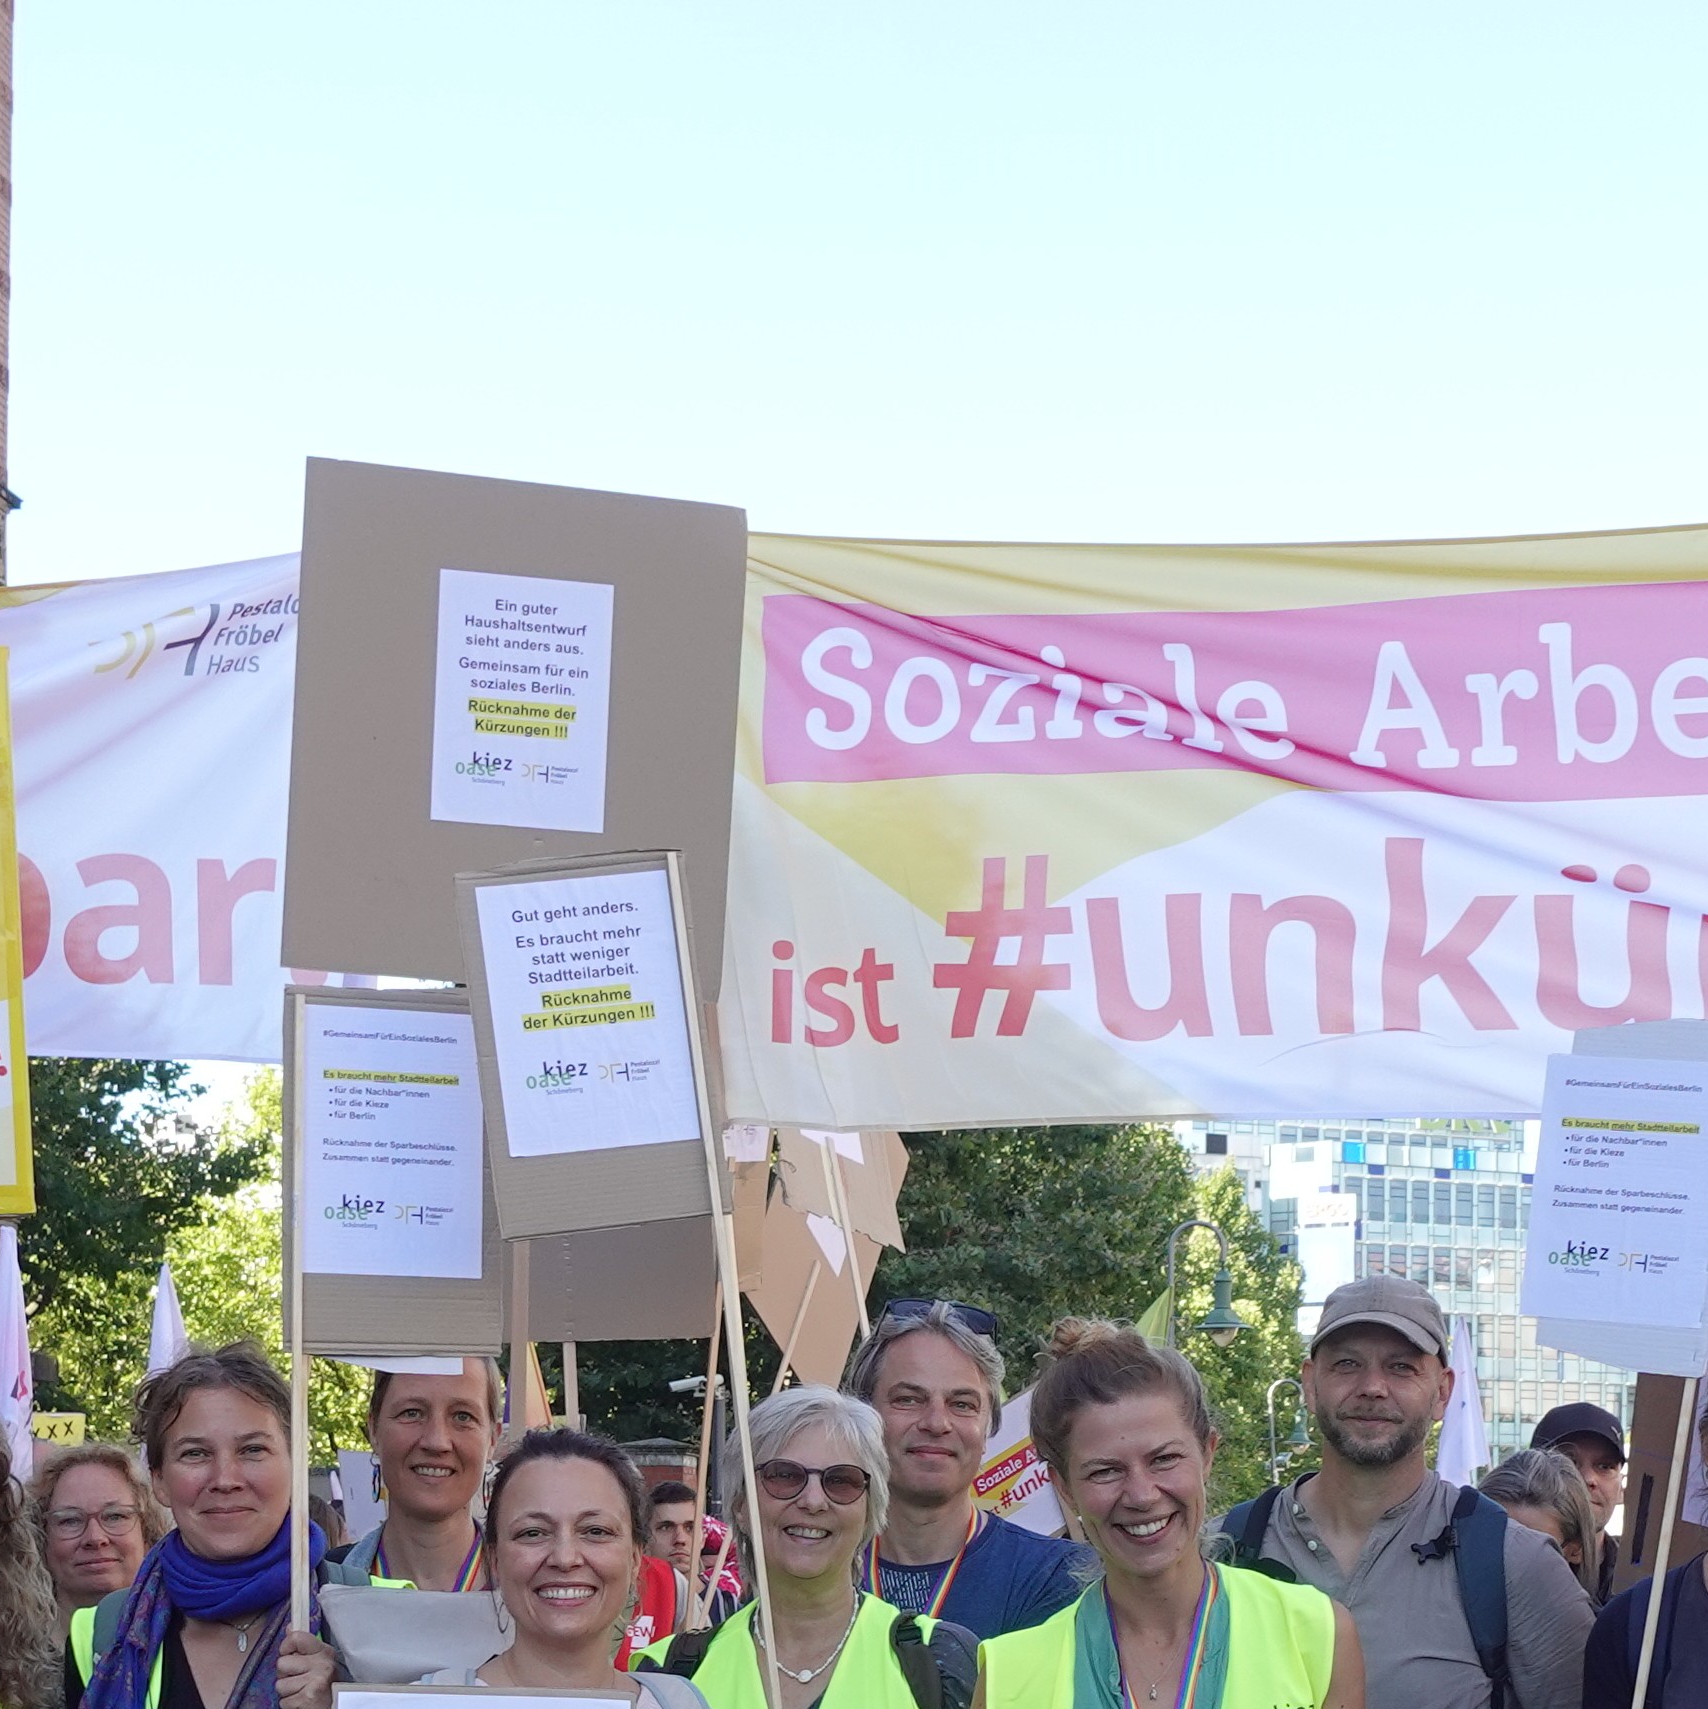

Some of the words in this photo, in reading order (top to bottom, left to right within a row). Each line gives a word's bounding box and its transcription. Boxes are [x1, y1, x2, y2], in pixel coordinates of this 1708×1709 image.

[228, 594, 300, 621] Pestal
[495, 598, 517, 612] Ein
[521, 604, 558, 616] guter
[213, 623, 284, 646] Fröbel
[465, 614, 587, 636] Haushaltsentwurf
[465, 634, 499, 647] sieht
[503, 638, 551, 652] anders
[555, 644, 583, 655] aus.
[206, 655, 260, 676] Haus
[458, 656, 540, 674] Gemeinsam
[545, 663, 564, 676] für
[568, 667, 588, 679] ein
[470, 678, 526, 692] soziales
[531, 681, 575, 696] Berlin.
[800, 626, 1295, 761] Soziale
[468, 699, 550, 718] Rücknahme
[554, 707, 576, 720] der
[475, 718, 550, 737] Kürzungen
[555, 725, 568, 738] !!!
[455, 761, 497, 777] oase
[472, 751, 513, 772] kiez
[511, 910, 539, 923] Gut
[543, 906, 577, 923] geht
[582, 901, 638, 916] anders.
[515, 935, 535, 948] Es
[539, 929, 598, 946] braucht
[602, 925, 641, 939] mehr
[532, 951, 566, 965] statt
[569, 946, 630, 961] weniger
[528, 962, 638, 984] Stadtteilarbeit.
[541, 990, 631, 1008] Rücknahme
[770, 939, 901, 1048] ist
[523, 1017, 548, 1029] der
[552, 1009, 635, 1026] Kürzungen
[640, 1004, 655, 1018] !!!
[323, 1069, 335, 1079] Es
[337, 1071, 372, 1080] braucht
[373, 1074, 400, 1083] mehr
[542, 1061, 588, 1079] kiez
[334, 1085, 347, 1094] für
[348, 1086, 363, 1095] die
[526, 1072, 571, 1090] oase
[334, 1098, 347, 1106] für
[349, 1099, 363, 1107] die
[365, 1099, 389, 1108] Kieze
[334, 1110, 347, 1118] für
[349, 1111, 376, 1120] Berlin
[322, 1137, 372, 1147] Rücknahme
[374, 1140, 388, 1148] der
[322, 1152, 369, 1162] Zusammen
[371, 1155, 389, 1163] statt
[977, 1458, 1023, 1492] Soziale
